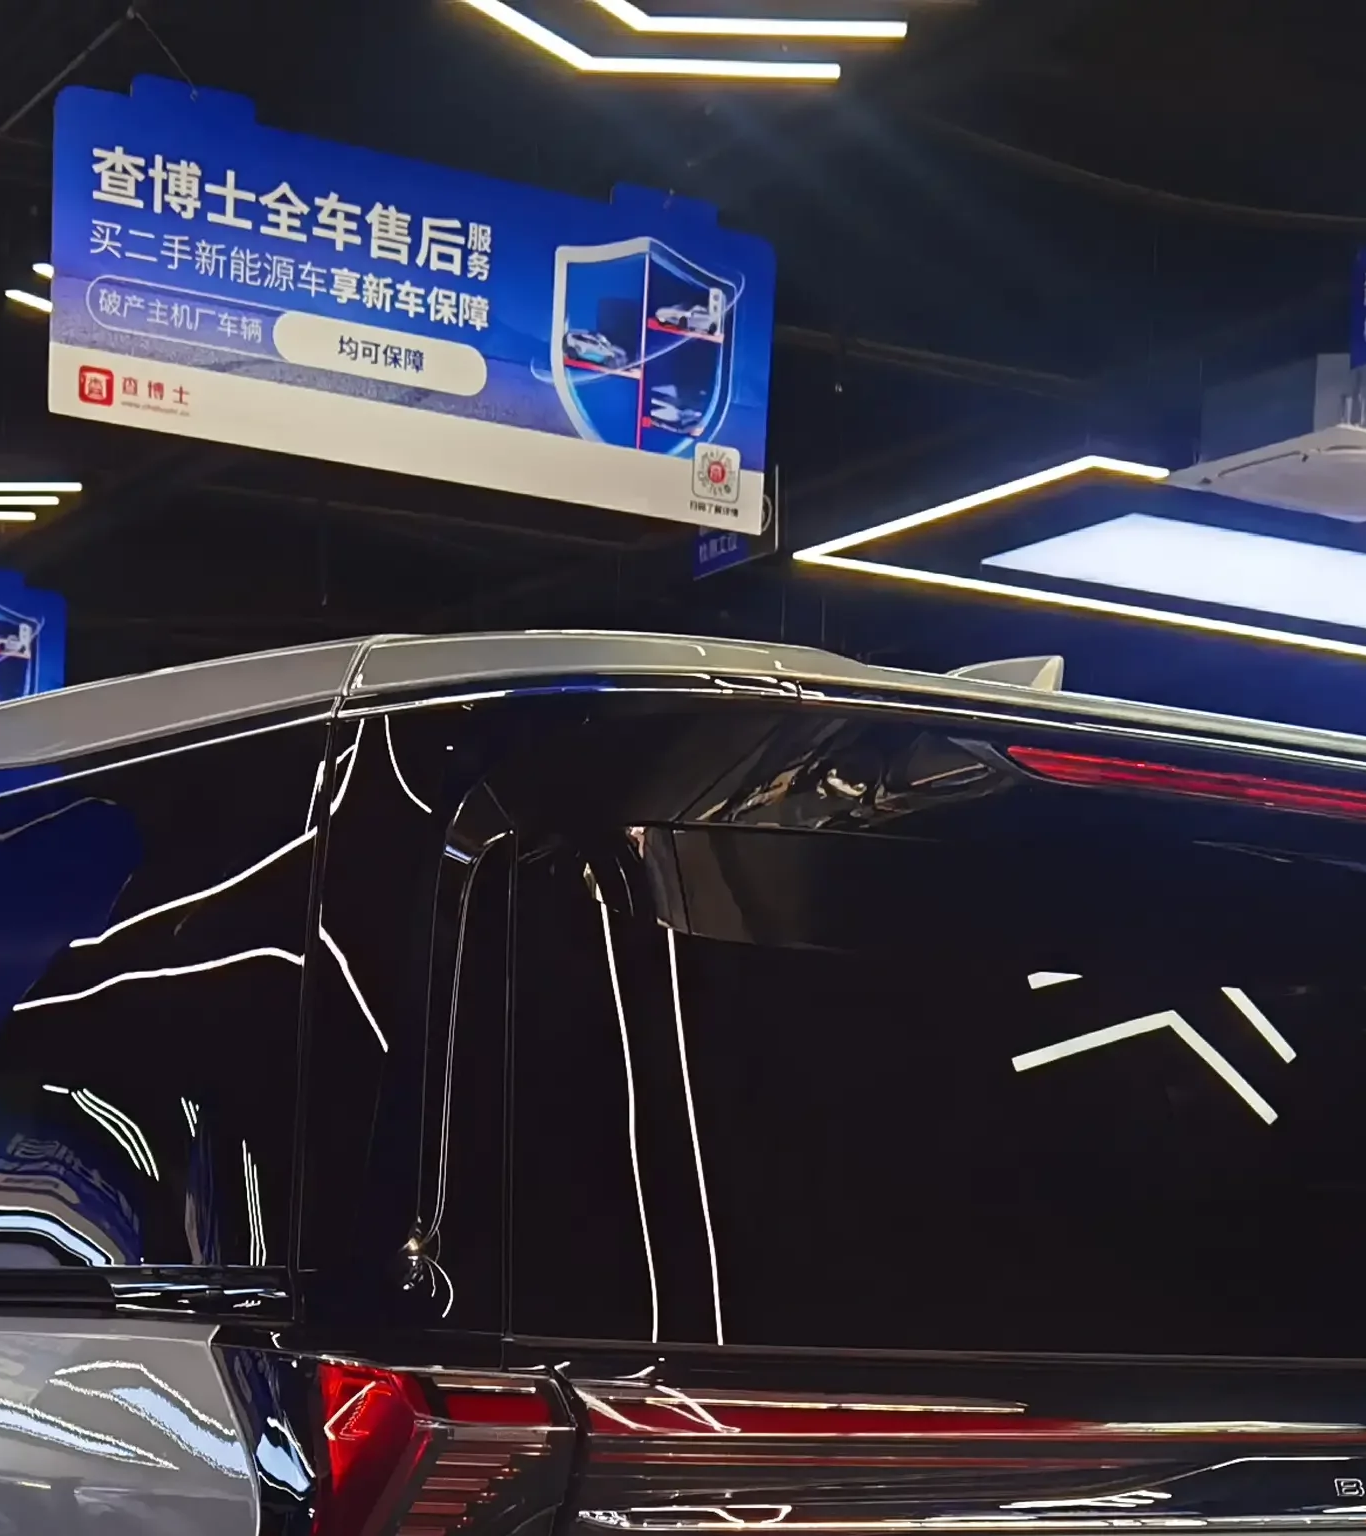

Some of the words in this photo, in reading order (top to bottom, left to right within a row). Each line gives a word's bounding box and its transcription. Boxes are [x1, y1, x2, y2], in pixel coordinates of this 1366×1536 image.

[91, 146, 463, 276] 查博士全车售后
[89, 219, 490, 332] 买二手新能源车享新车保障
[97, 288, 263, 345] 破产主机厂车辆
[337, 334, 426, 375] 均可保障
